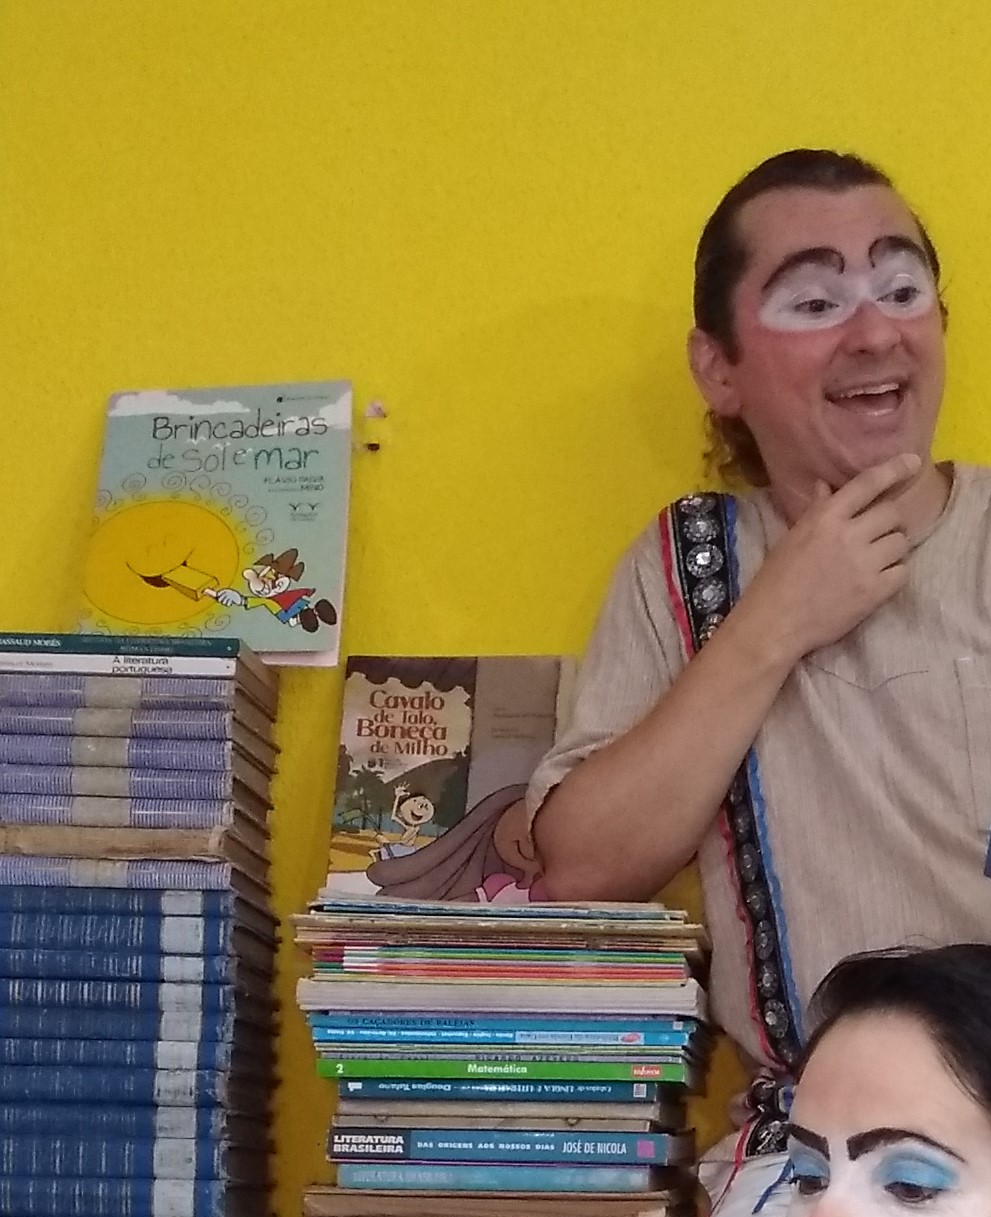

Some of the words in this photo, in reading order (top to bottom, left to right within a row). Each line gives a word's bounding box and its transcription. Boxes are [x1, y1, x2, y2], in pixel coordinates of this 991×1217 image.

[153, 408, 328, 440] Brincadeiras
[147, 444, 175, 469] de
[233, 448, 247, 465] e
[0, 638, 31, 647] ASSAUD
[112, 656, 121, 664] A
[123, 656, 169, 665] literatura
[112, 664, 173, 674] portuguesa
[370, 690, 445, 711] Cavalo
[374, 710, 394, 724] de
[356, 718, 447, 741] Boneca
[370, 741, 387, 754] de
[394, 740, 448, 756] Milho
[335, 1063, 345, 1074] 2
[467, 1062, 528, 1075] Matemática
[333, 1134, 405, 1145] LITERATURA
[417, 1141, 433, 1149] DAS
[438, 1141, 473, 1150] ORIGENS
[478, 1142, 494, 1150] AOS
[535, 1142, 555, 1151] DIAS
[562, 1138, 582, 1153] JOSÉ
[584, 1141, 595, 1153] DE
[597, 1142, 627, 1155] NICOLA
[333, 1144, 404, 1155] BRASILEIRA
